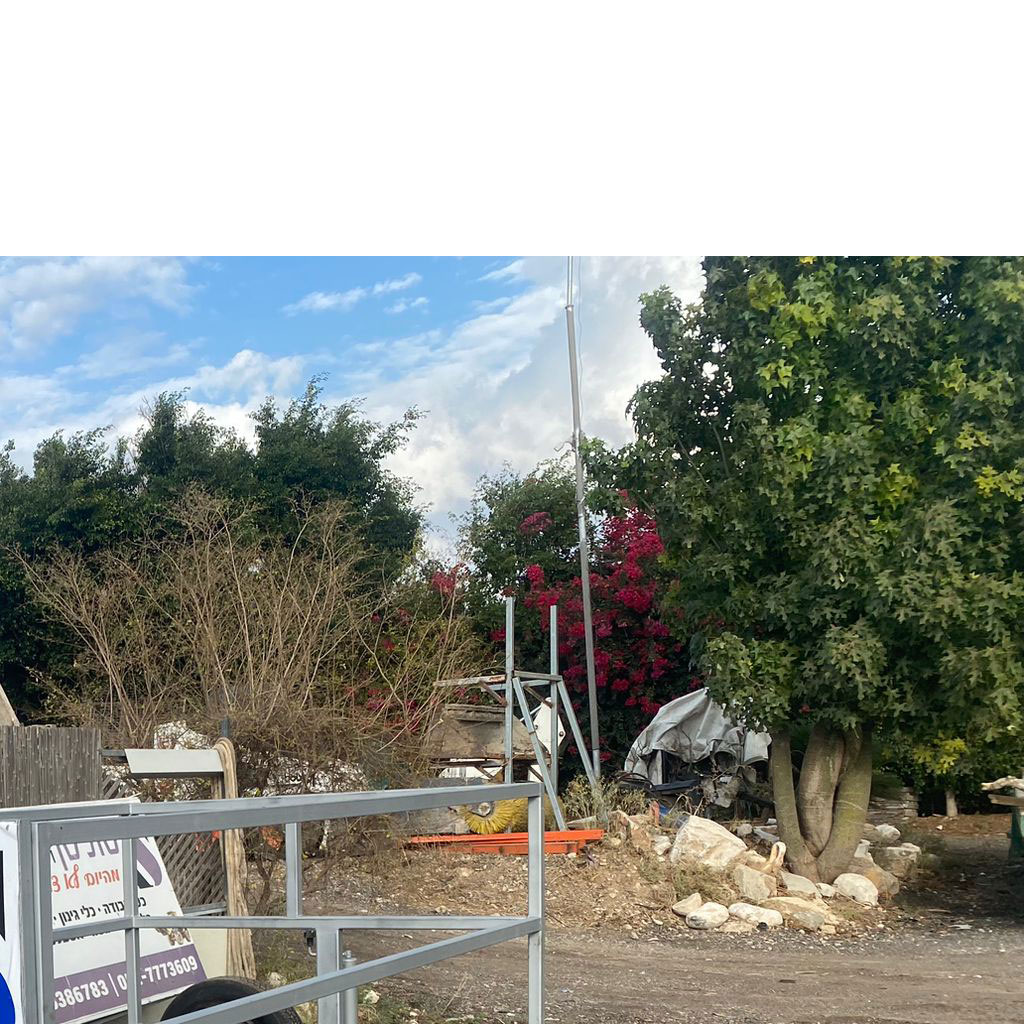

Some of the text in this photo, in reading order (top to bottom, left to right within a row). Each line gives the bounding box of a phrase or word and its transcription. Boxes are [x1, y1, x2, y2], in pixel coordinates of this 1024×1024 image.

[64, 863, 80, 890] לא
[83, 869, 120, 887] מהיום
[58, 910, 80, 927] גינון
[80, 905, 96, 918] כלי
[117, 955, 198, 991] 0-7773609
